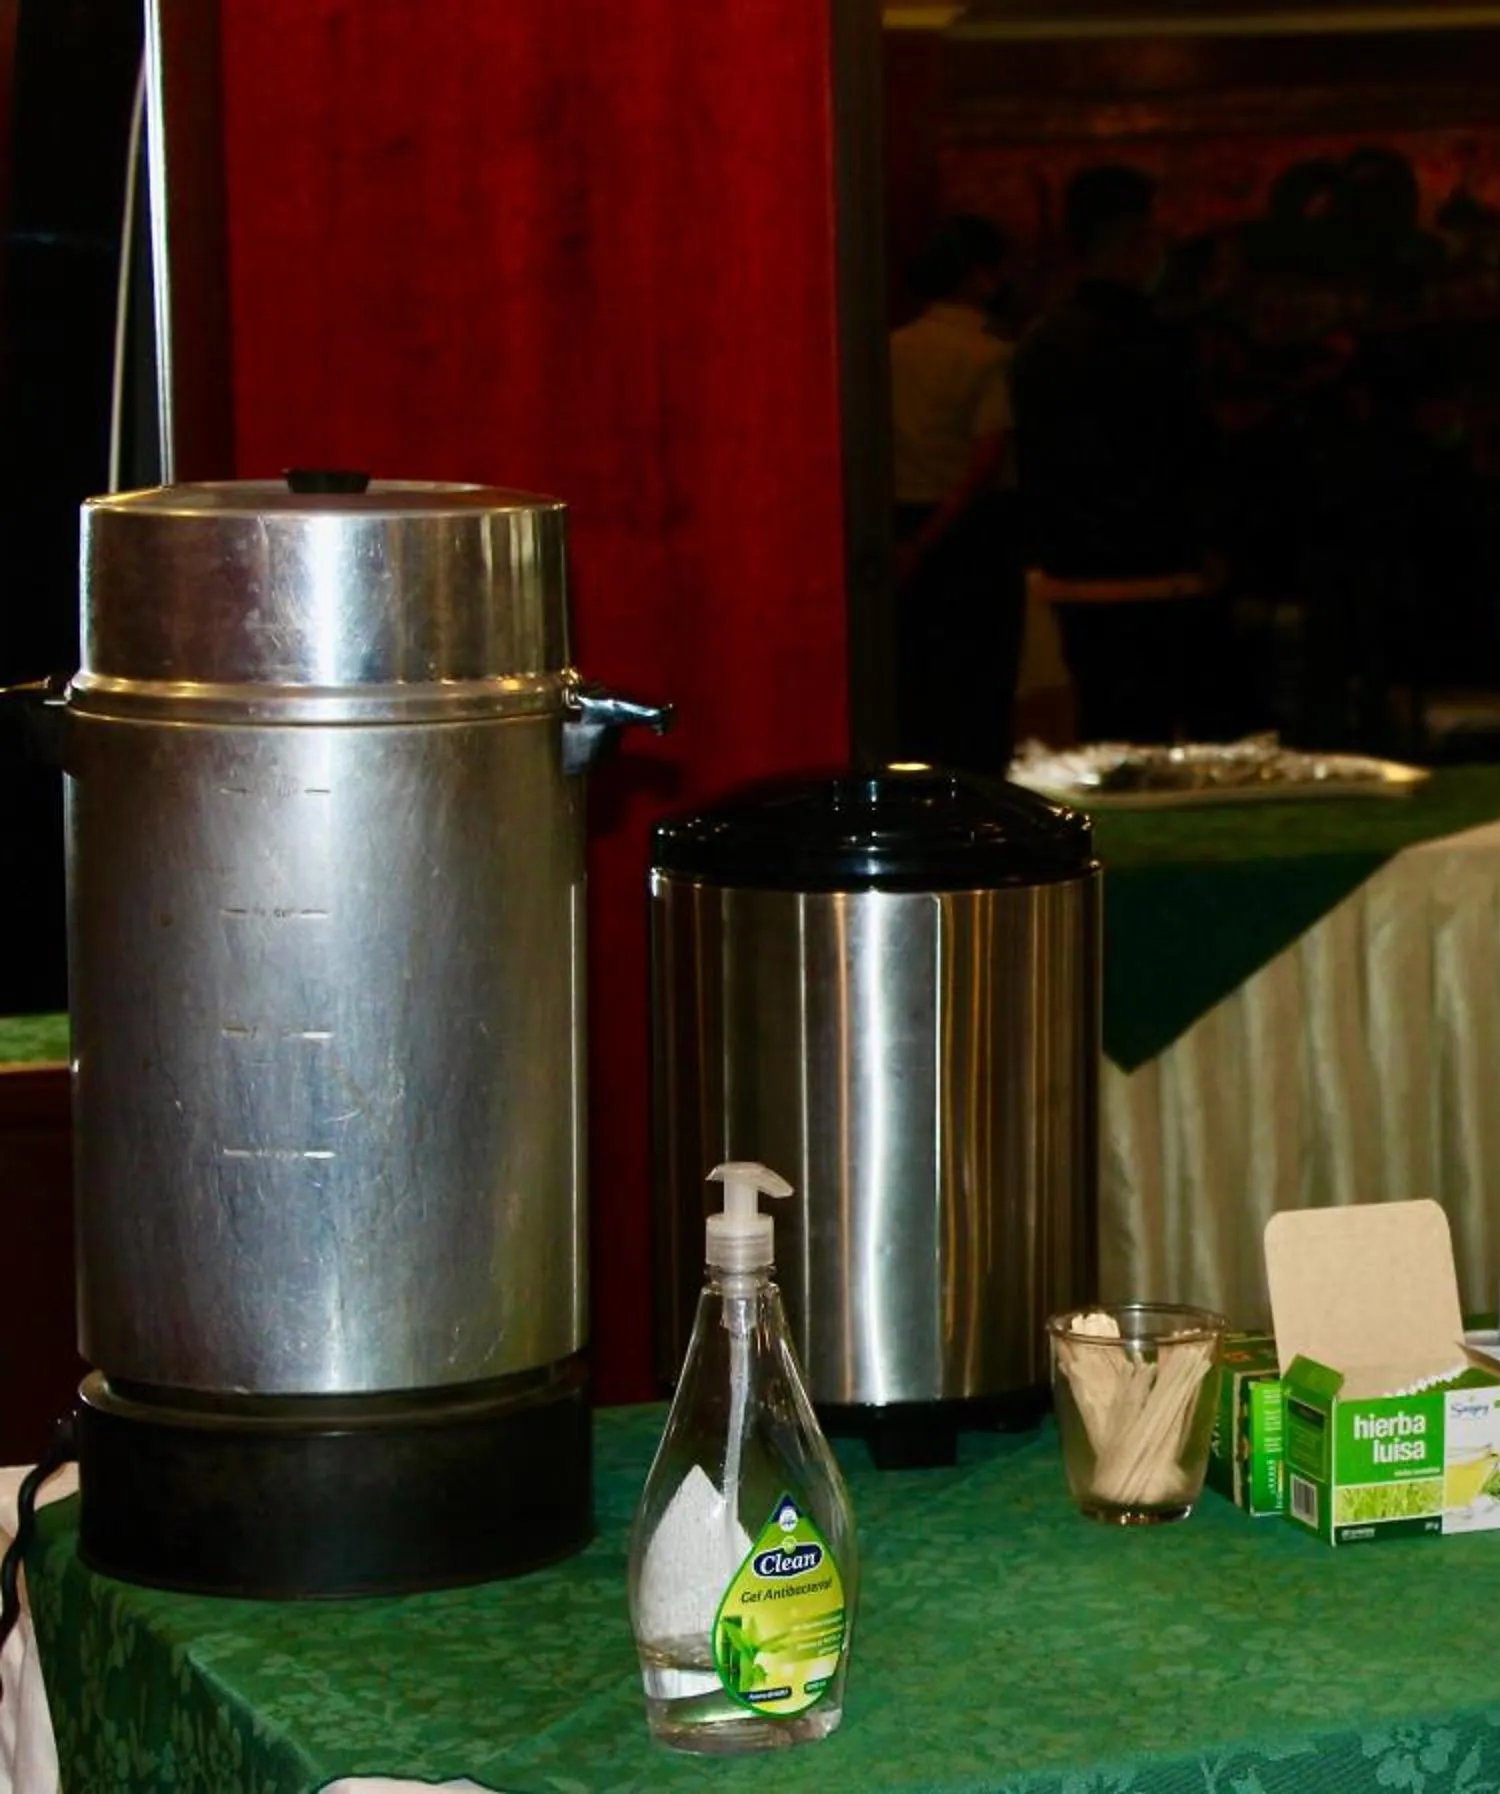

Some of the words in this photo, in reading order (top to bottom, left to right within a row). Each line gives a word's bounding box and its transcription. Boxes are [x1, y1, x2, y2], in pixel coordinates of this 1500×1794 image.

[1354, 1411, 1426, 1440] hierba
[1373, 1438, 1426, 1464] luisa
[760, 1552, 817, 1575] Clean
[741, 1591, 761, 1604] Gel
